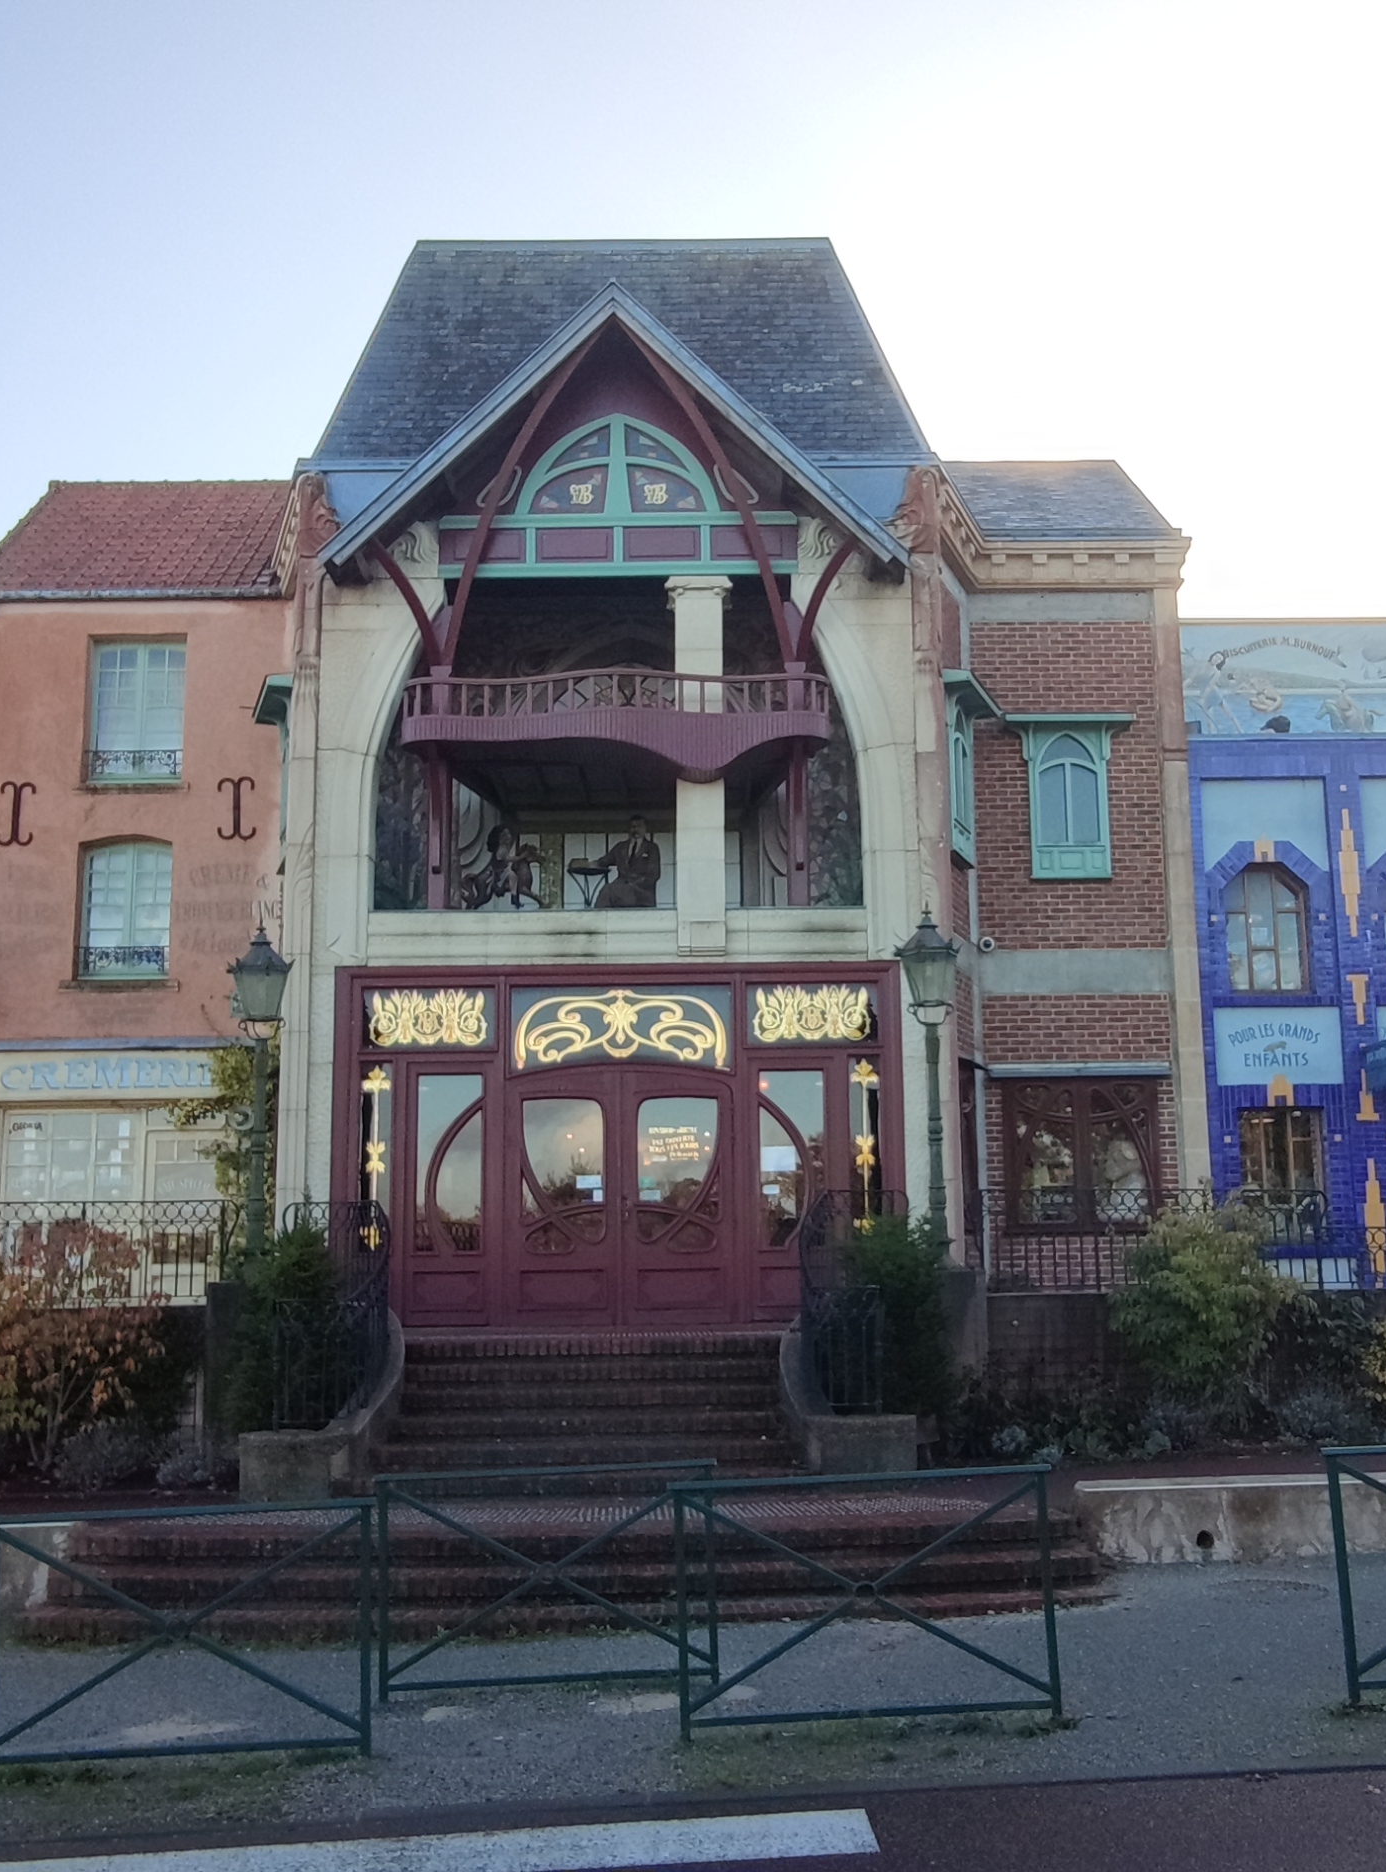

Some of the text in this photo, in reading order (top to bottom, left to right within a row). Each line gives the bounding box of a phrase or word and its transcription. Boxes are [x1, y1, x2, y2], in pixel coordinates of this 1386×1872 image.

[1228, 1023, 1321, 1047] POUR LES GRANDS
[1244, 1052, 1309, 1067] ENFANTS
[1, 1058, 215, 1091] CREMERI
